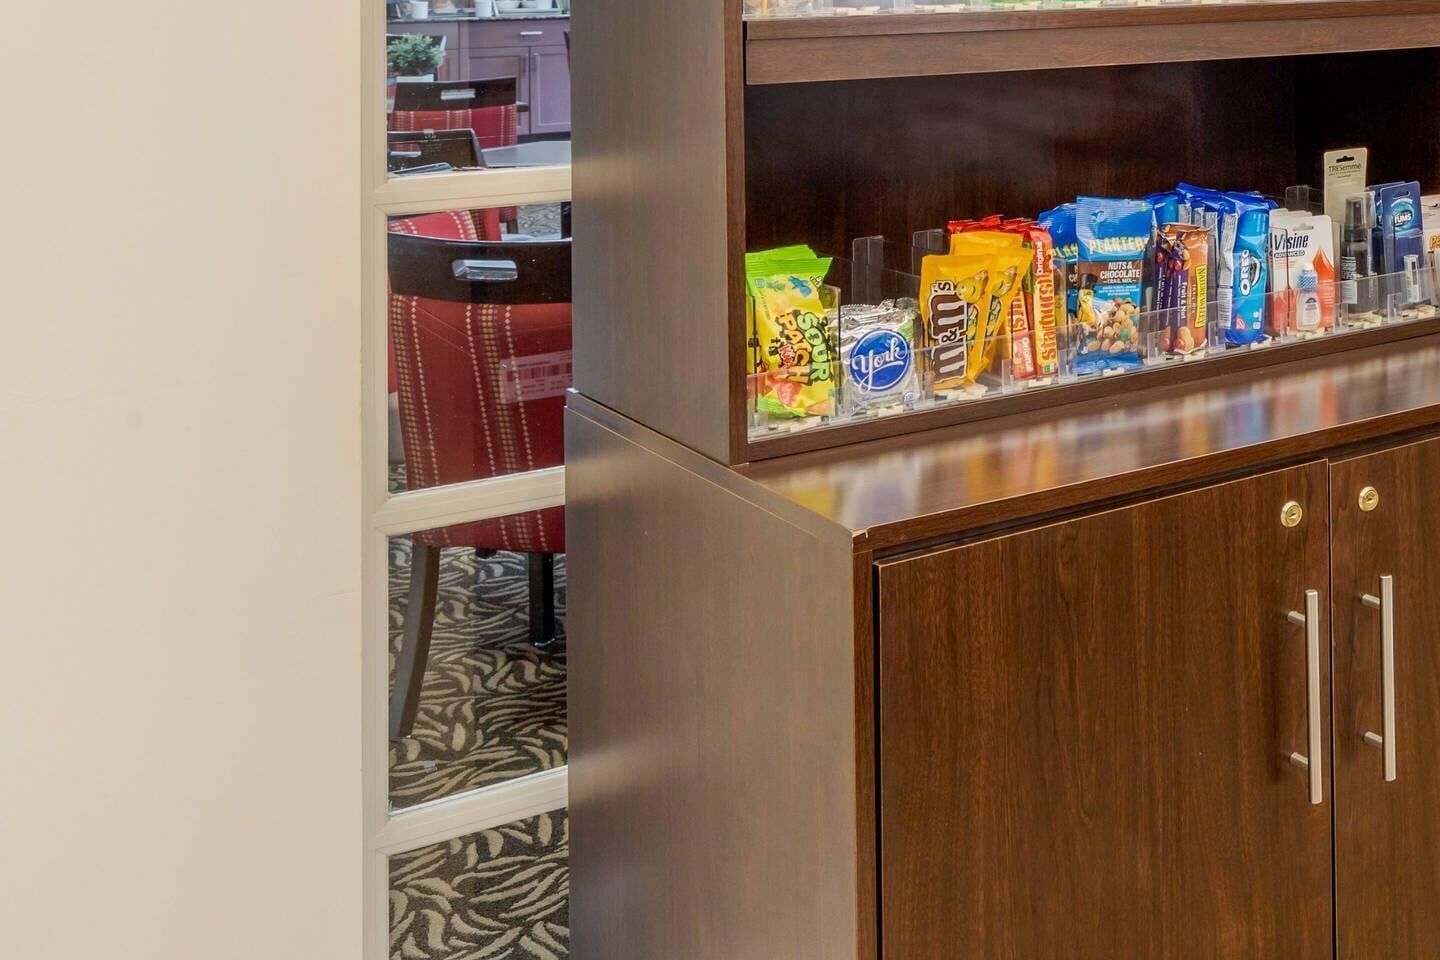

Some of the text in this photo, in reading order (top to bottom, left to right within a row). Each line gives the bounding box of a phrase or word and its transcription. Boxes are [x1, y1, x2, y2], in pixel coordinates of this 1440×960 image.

[1394, 211, 1412, 225] TUMS
[1274, 233, 1309, 251] Visine
[1100, 269, 1140, 279] CHOCOLATE
[1108, 261, 1125, 271] NUTS
[1240, 249, 1250, 296] OREO
[775, 311, 813, 384] PATCH
[796, 311, 831, 382] SOUR
[850, 336, 906, 394] York
